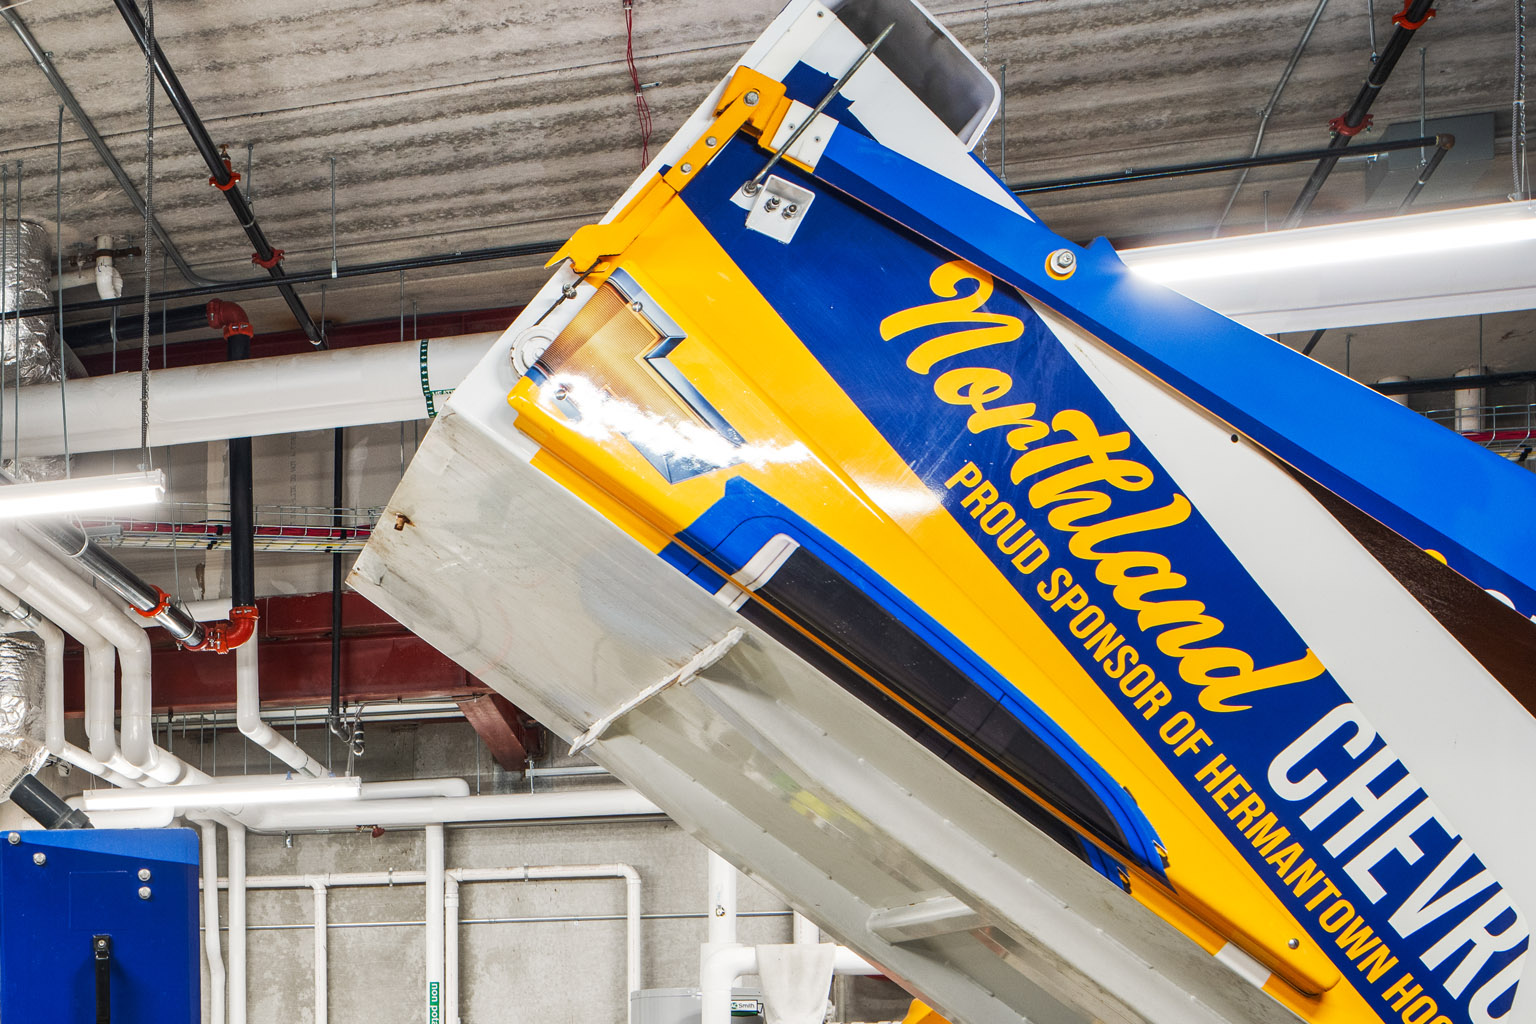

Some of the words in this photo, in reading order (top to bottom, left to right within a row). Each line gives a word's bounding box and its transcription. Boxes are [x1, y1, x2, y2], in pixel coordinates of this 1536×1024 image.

[879, 259, 1326, 713] Northland
[945, 461, 1051, 575] PROUD
[1037, 568, 1173, 721] SPONSOR
[1159, 711, 1213, 757] OF
[1193, 753, 1399, 984] HERMANTOWN
[431, 983, 439, 1002] non
